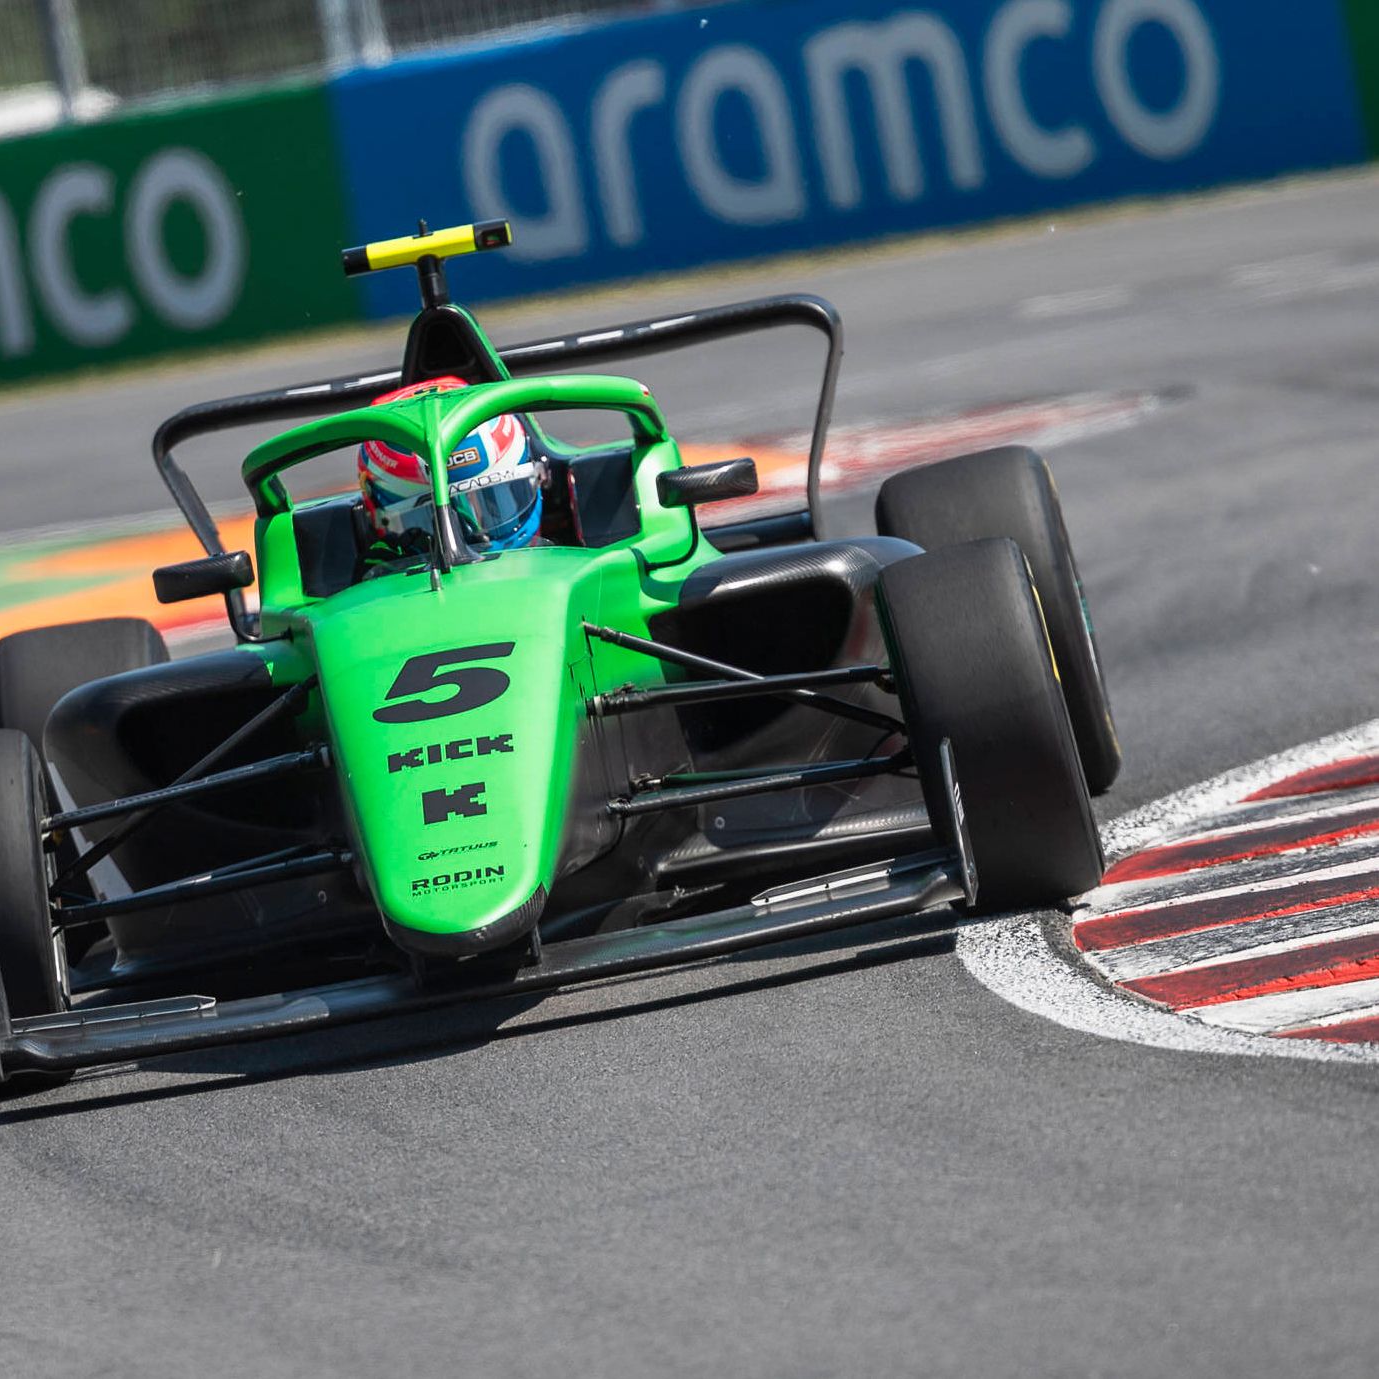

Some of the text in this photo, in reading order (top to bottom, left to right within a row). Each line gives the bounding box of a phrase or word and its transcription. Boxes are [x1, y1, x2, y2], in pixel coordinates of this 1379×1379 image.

[460, 0, 1219, 262] aramco
[447, 450, 476, 467] JCB
[372, 641, 516, 724] 5
[387, 734, 514, 773] KICK
[422, 781, 487, 825] K
[411, 865, 504, 891] RODIN
[412, 877, 505, 897] MOTORSPORT
